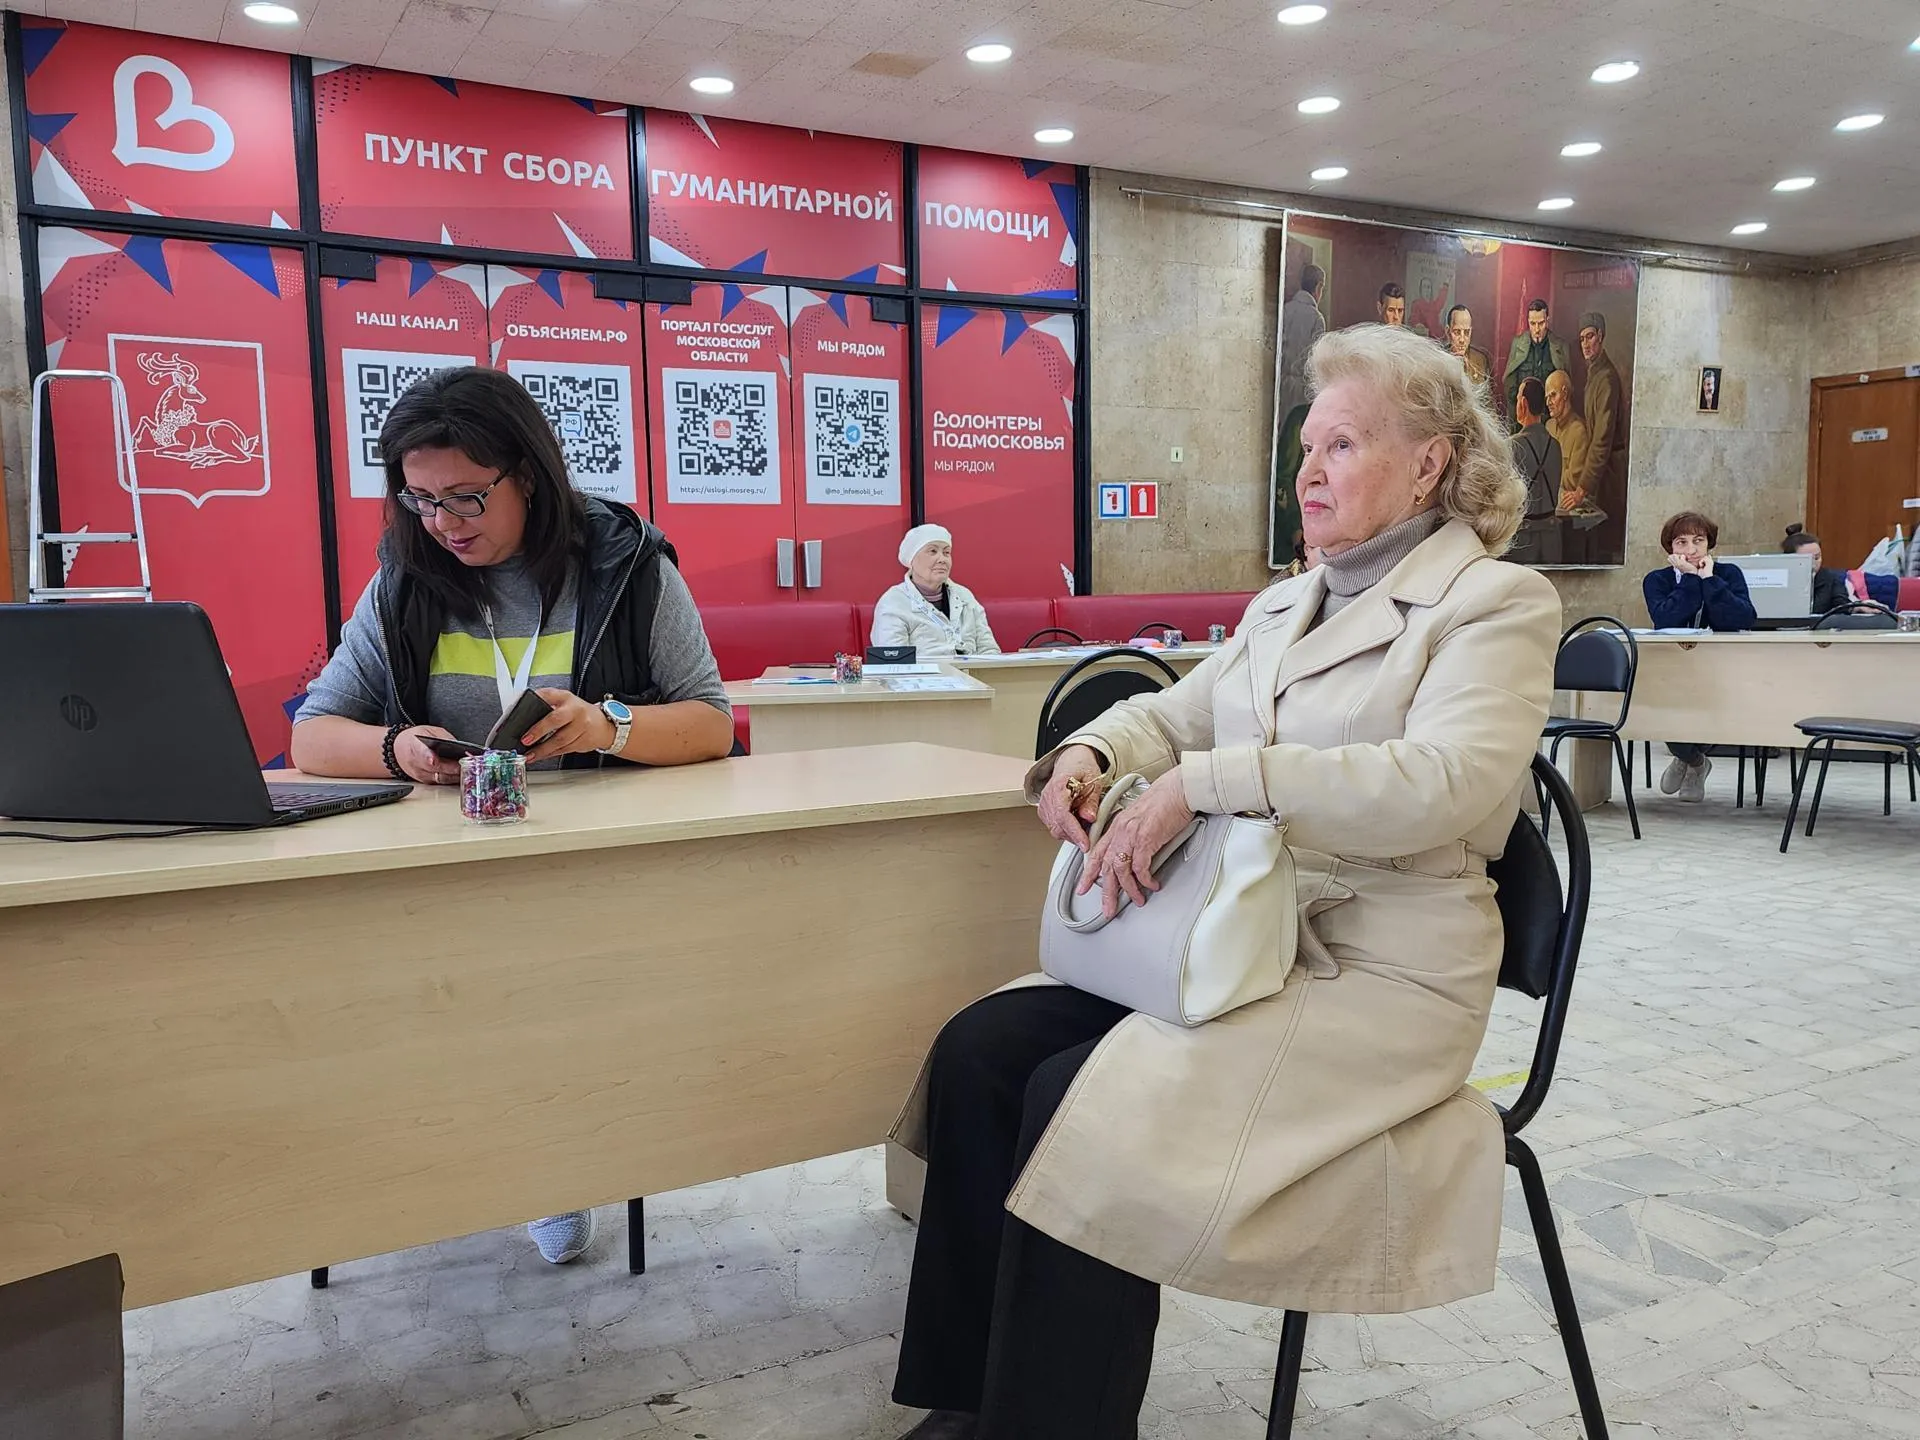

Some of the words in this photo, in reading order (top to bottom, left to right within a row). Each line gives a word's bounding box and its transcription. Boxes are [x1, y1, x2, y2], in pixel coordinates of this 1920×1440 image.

[365, 132, 488, 175] ПУНКТ
[503, 152, 615, 191] СБОРА
[650, 169, 893, 222] ГУМАНИТАРНОЙ
[925, 202, 1049, 242] ПОМОЩИ
[356, 311, 396, 327] НАШ
[400, 314, 459, 331] КАНАЛ
[661, 319, 710, 333] ПОРТАЛ
[713, 322, 774, 336] ГОСУСЛУГ
[507, 323, 628, 343] ОБЪЯСНЯЕМ.РФ
[676, 334, 761, 349] МОСКОВСКОЙ
[817, 339, 838, 353] МЫ
[841, 342, 885, 357] РЯДОМ
[690, 350, 749, 364] ОБЛАСТИ
[934, 460, 953, 472] МЫ
[955, 460, 995, 474] РЯДОМ
[680, 486, 767, 494] https://uslugi.mosreg.ru/
[68, 694, 91, 732] hp
